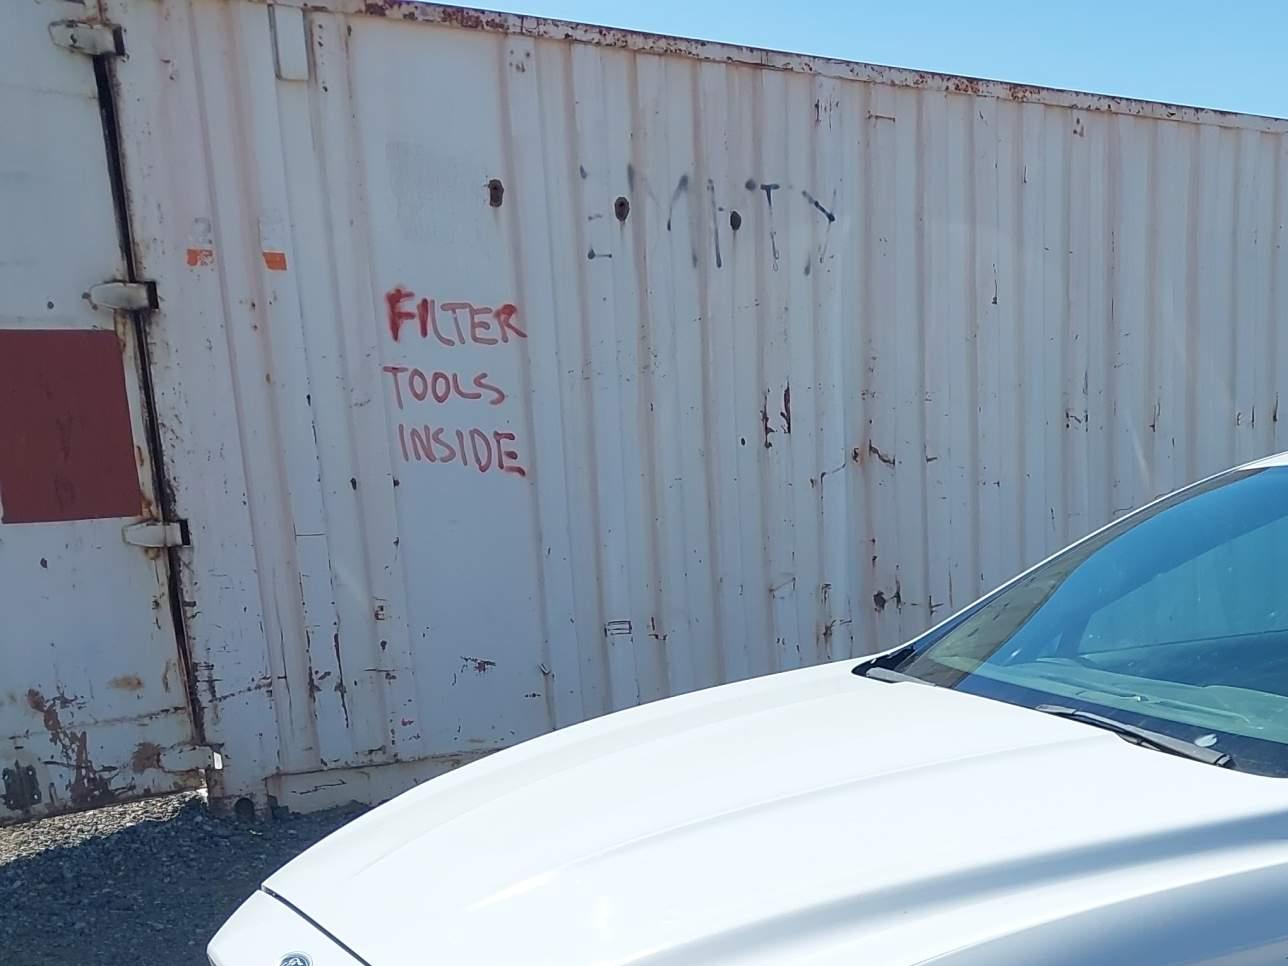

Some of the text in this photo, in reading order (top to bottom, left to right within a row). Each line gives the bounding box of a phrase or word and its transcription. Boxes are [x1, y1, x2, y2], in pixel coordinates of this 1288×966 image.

[385, 287, 528, 347] FILTER
[383, 366, 505, 410] TOOLS
[398, 423, 526, 477] INSIDE
